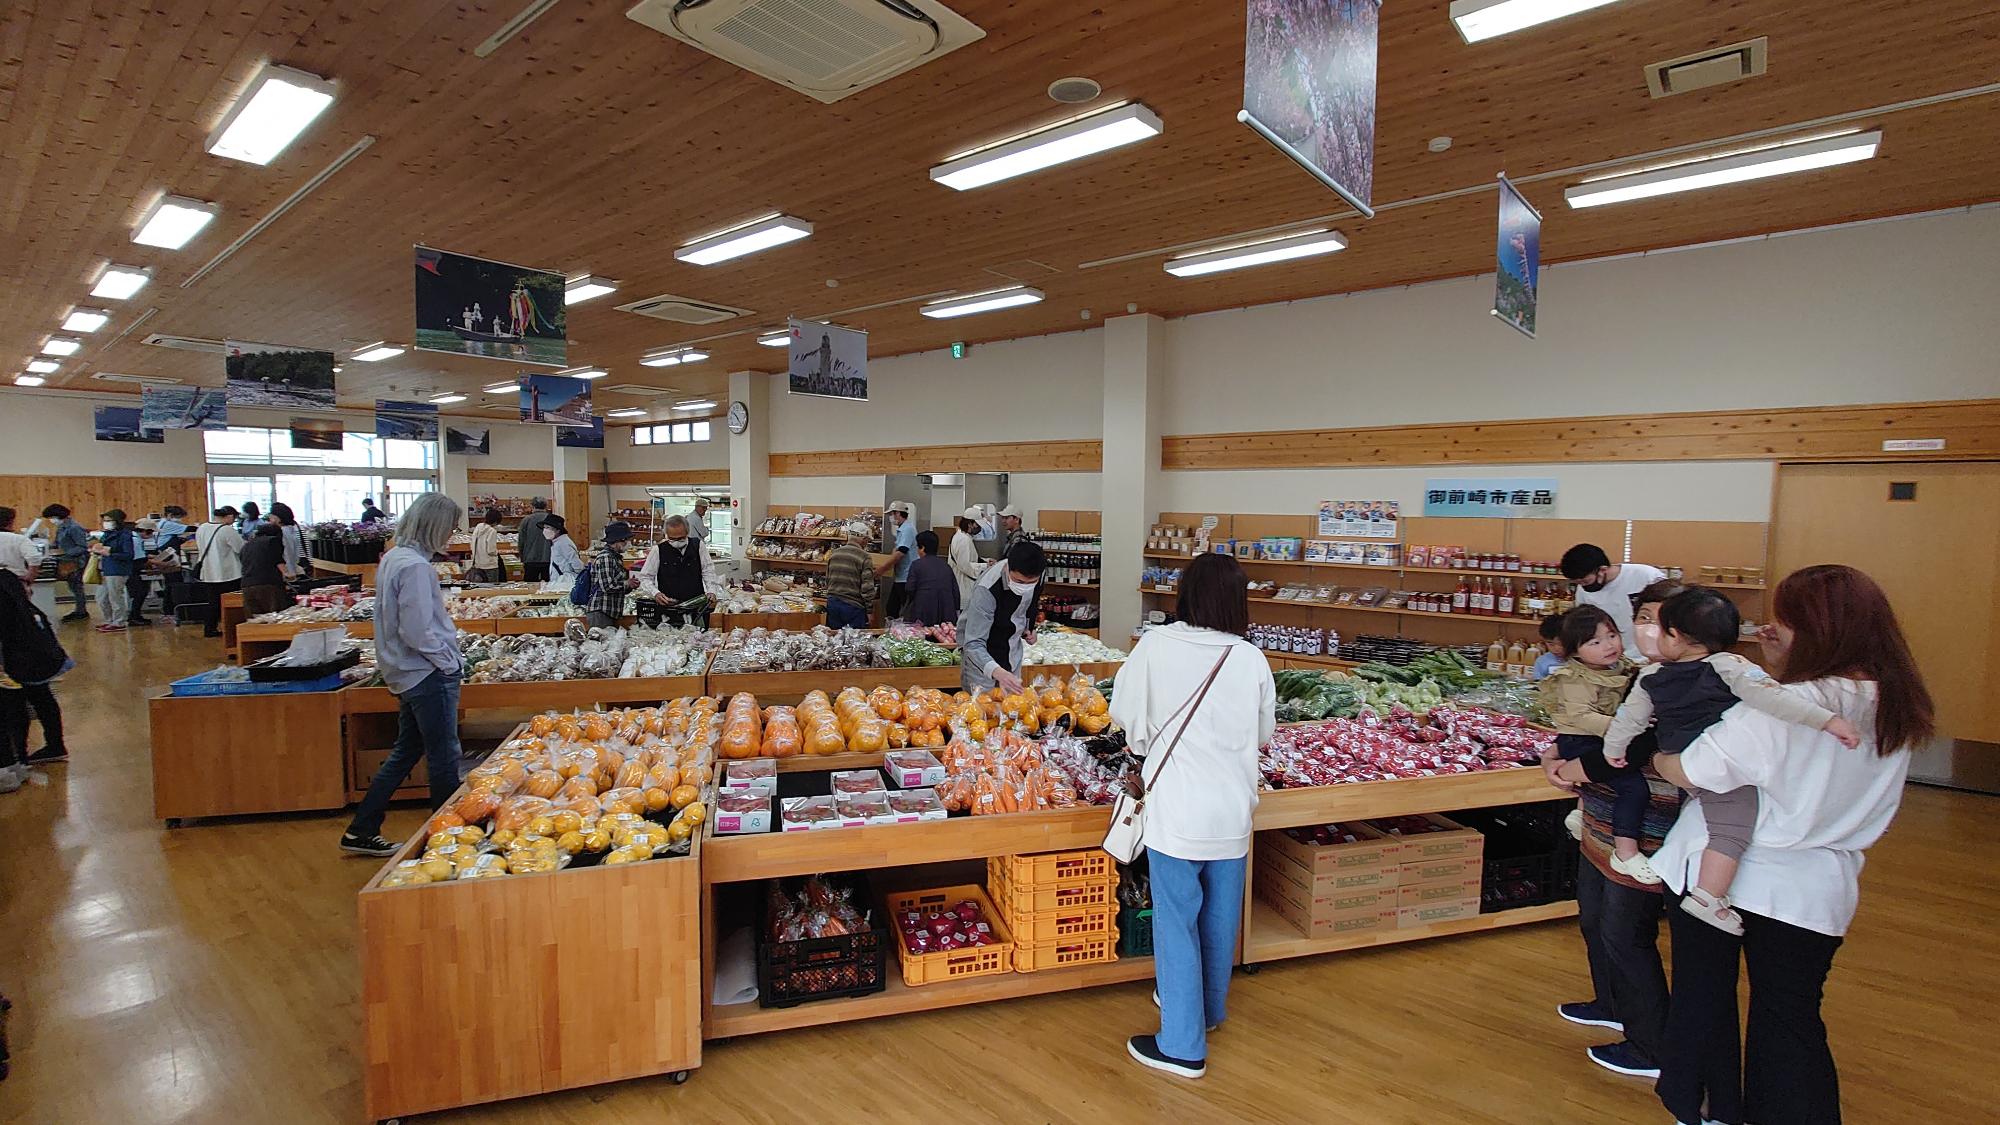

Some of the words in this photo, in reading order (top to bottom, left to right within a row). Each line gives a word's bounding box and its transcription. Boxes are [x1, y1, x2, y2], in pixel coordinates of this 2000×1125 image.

[1428, 489, 1552, 505] 御前崎市産品
